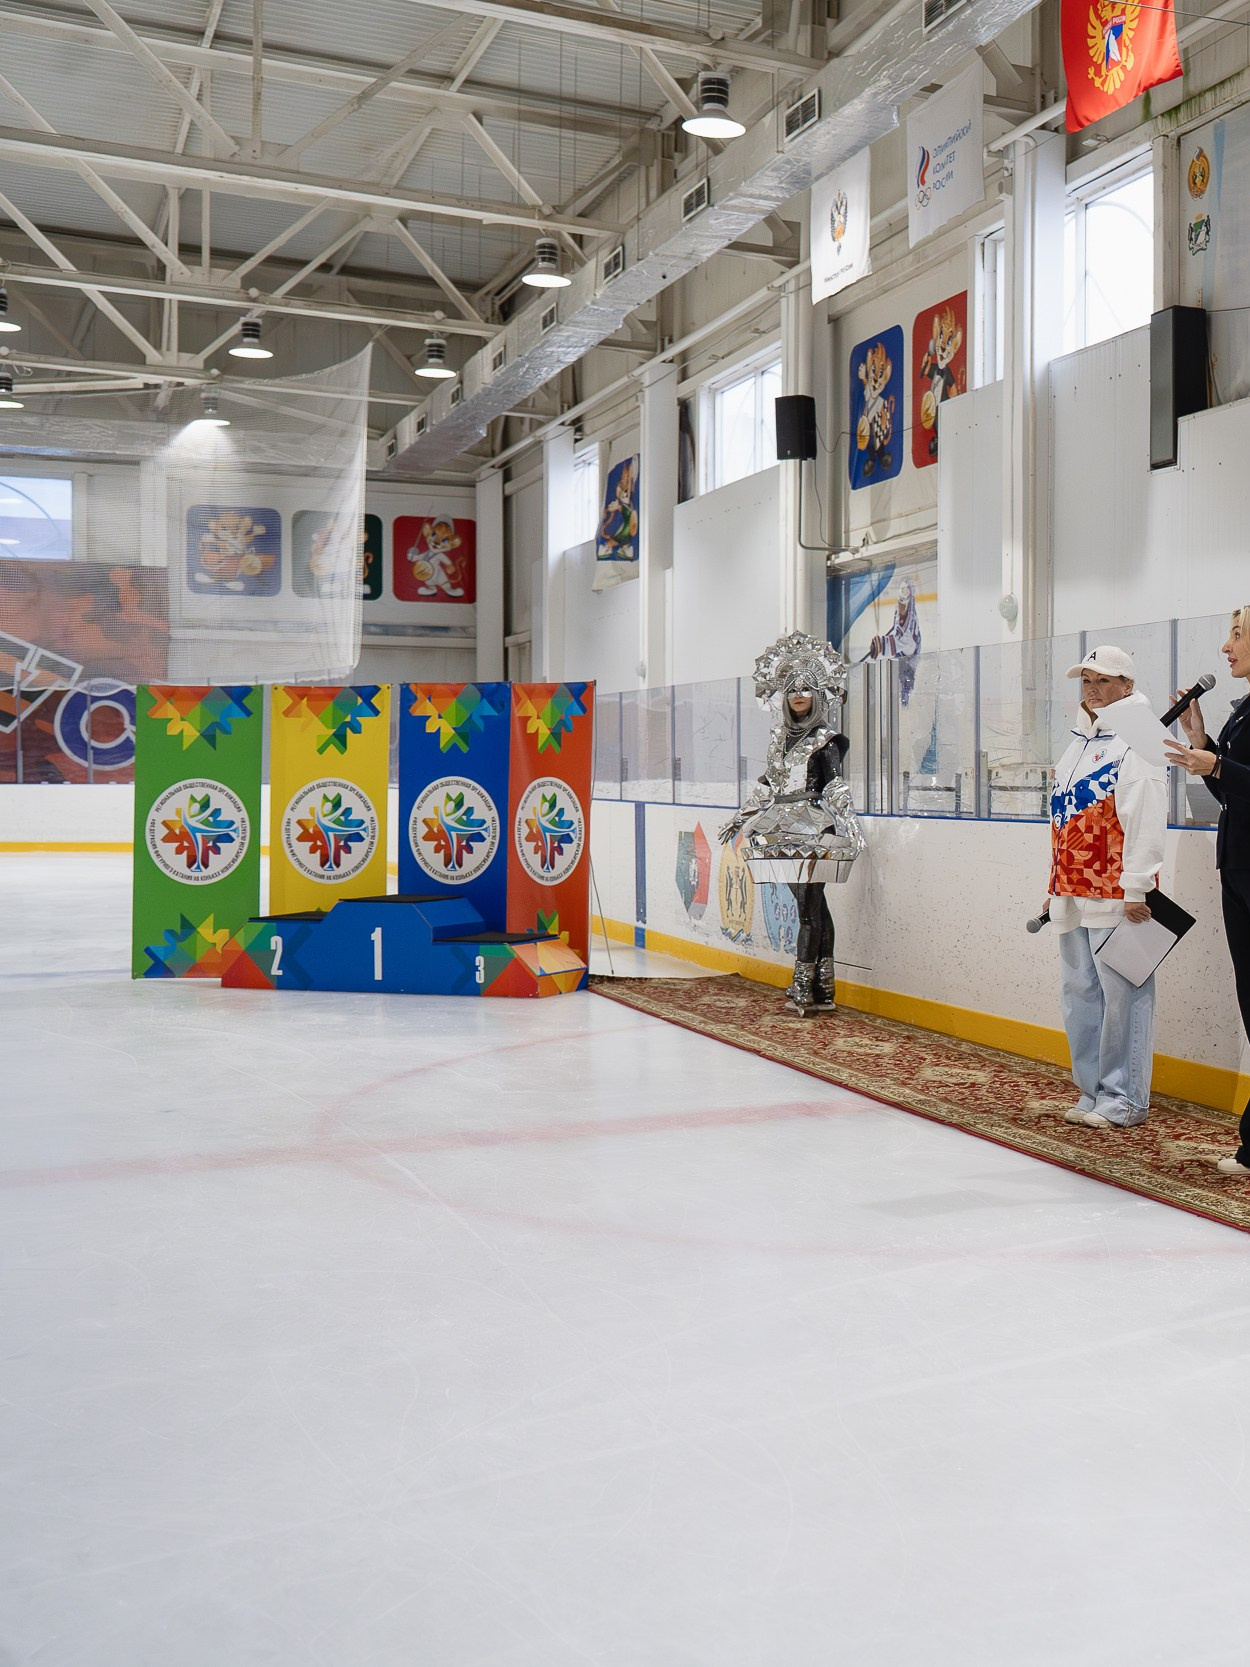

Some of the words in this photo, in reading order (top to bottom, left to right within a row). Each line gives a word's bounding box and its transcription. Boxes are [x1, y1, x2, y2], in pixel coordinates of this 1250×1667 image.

[1087, 651, 1097, 661] A
[270, 935, 283, 976] 2
[371, 927, 383, 981] 1
[475, 956, 485, 984] 3
